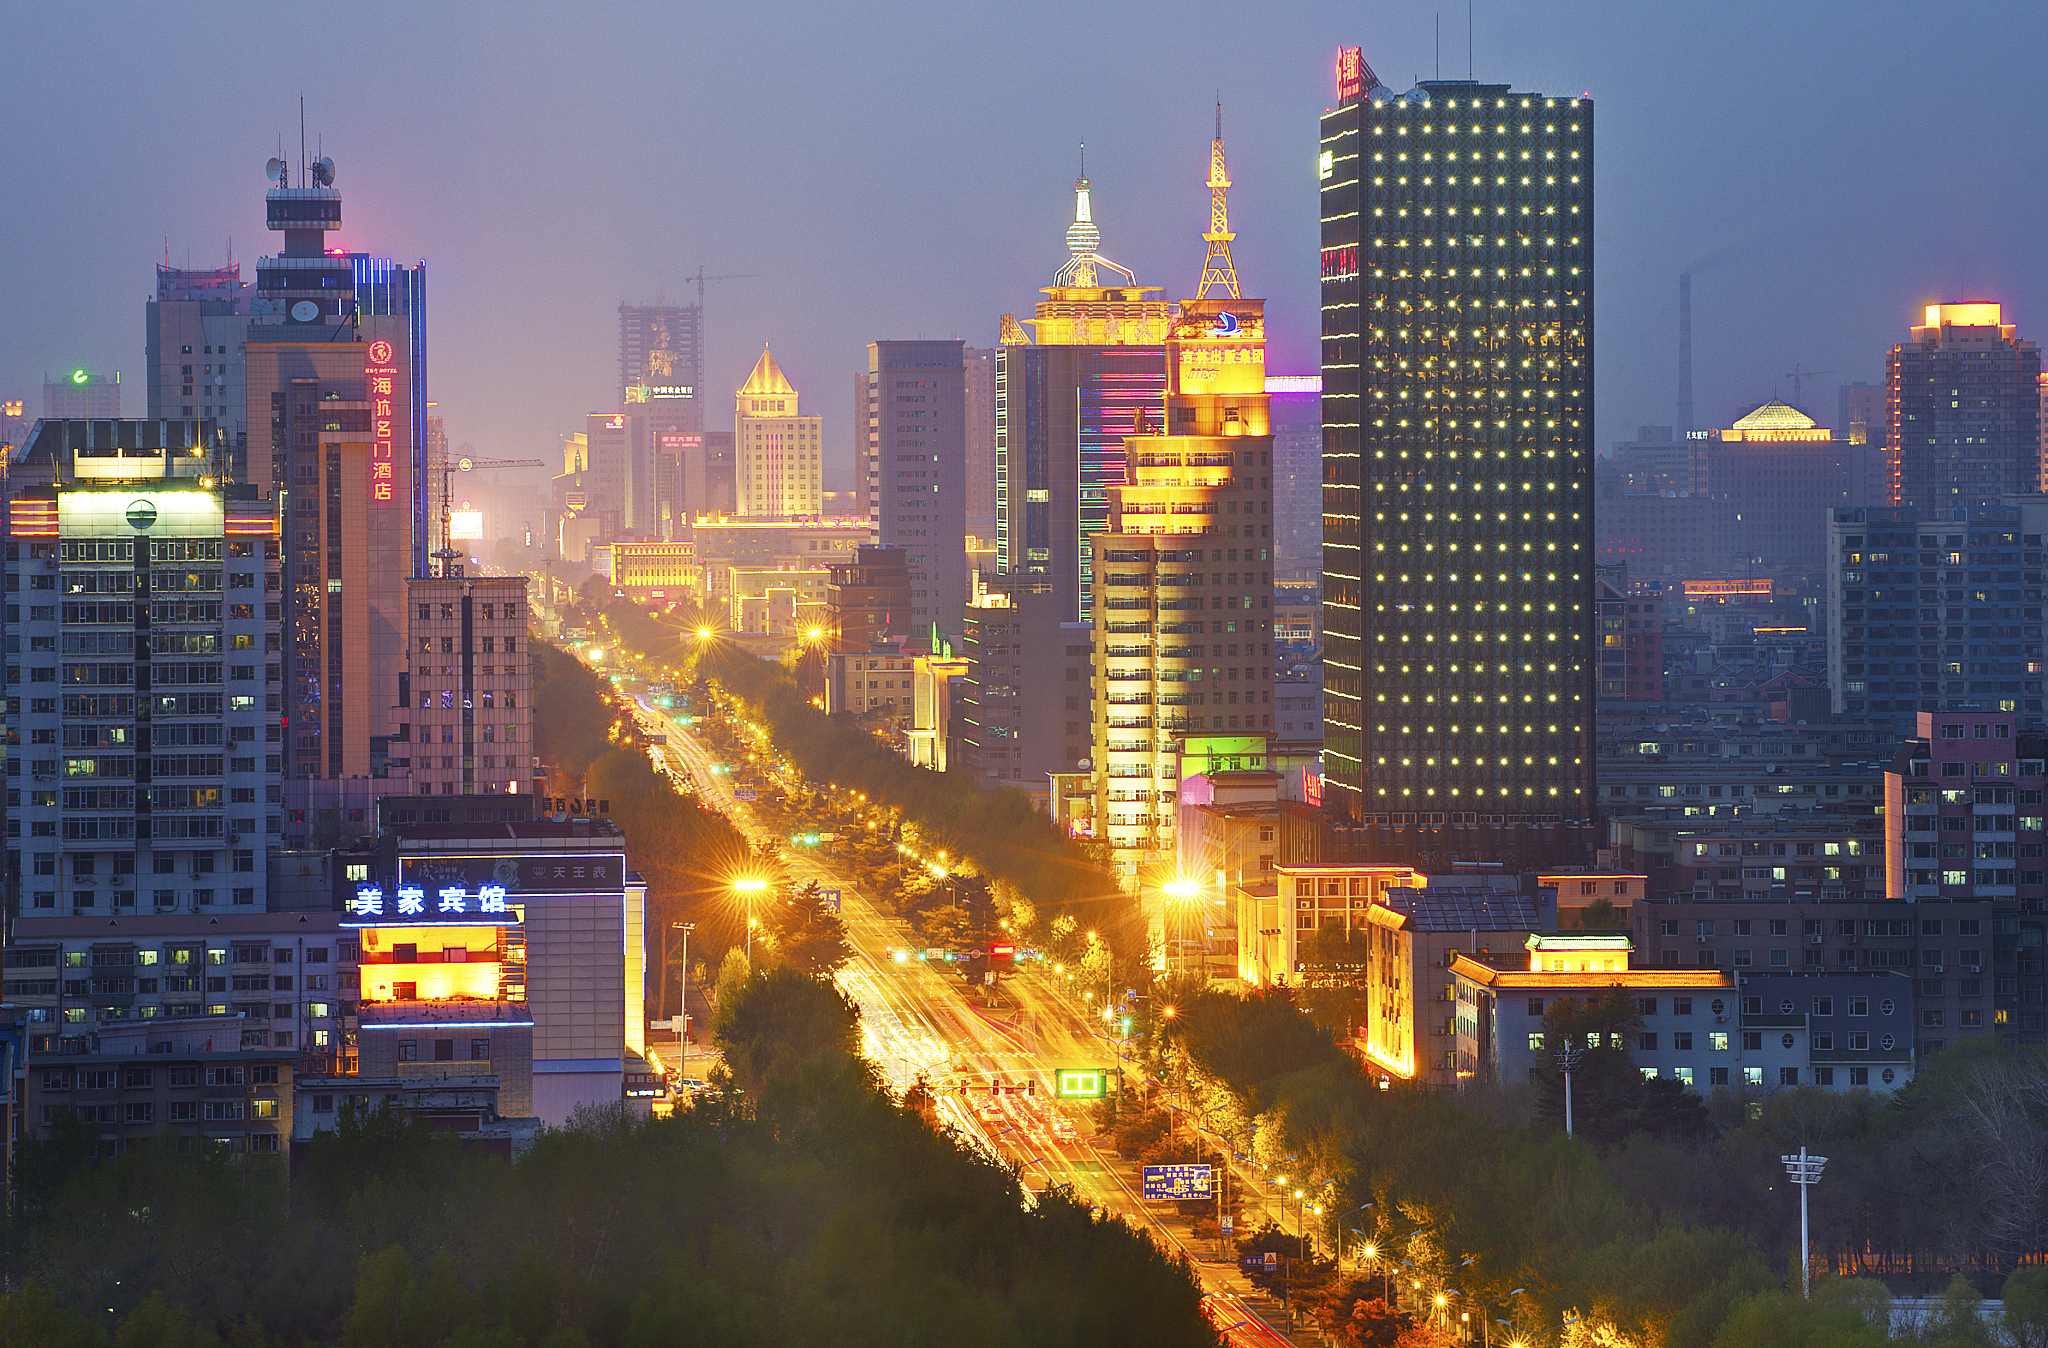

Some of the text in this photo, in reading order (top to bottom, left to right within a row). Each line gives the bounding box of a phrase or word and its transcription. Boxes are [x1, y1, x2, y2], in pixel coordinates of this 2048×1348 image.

[1181, 348, 1264, 364] 吉林出版集团
[653, 386, 693, 394] 中国农业银行
[372, 376, 392, 500] 海航名门酒店
[553, 866, 606, 879] 天王表
[356, 886, 506, 916] 美家宾馆
